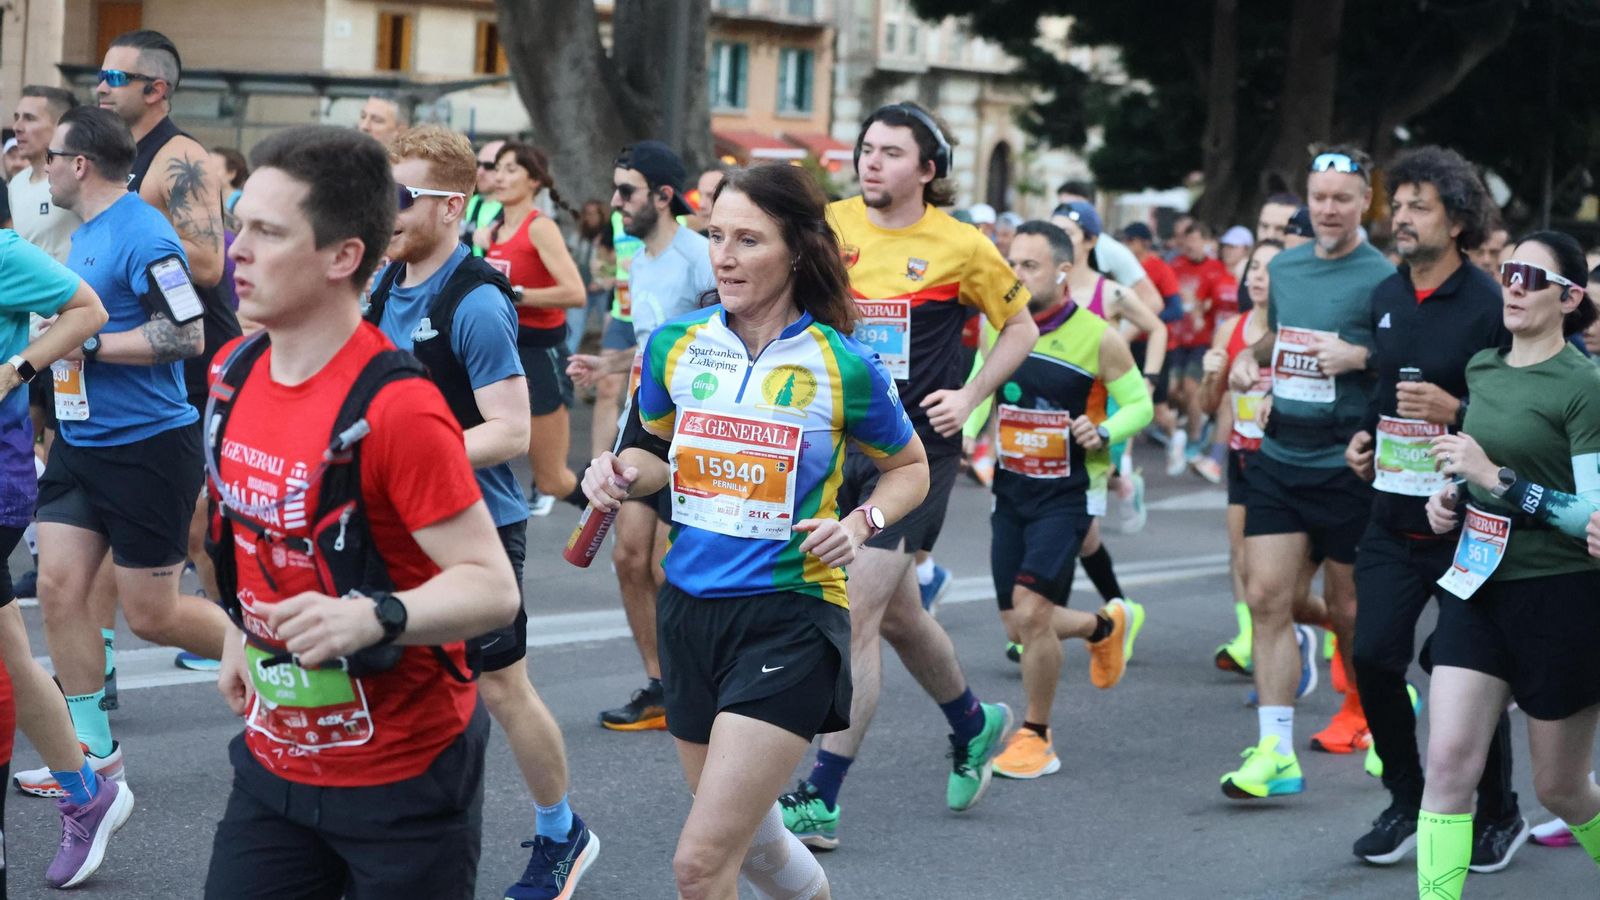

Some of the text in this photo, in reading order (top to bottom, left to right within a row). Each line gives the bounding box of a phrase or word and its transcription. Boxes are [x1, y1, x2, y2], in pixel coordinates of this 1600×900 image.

[858, 305, 902, 317] NERALI
[854, 328, 889, 344] 394
[688, 345, 743, 360] Sparbanken
[689, 357, 738, 372] Lidköping
[1283, 352, 1319, 371] 16172
[693, 382, 715, 392] dina
[704, 418, 790, 446] GENERALI
[1014, 431, 1048, 448] 2853
[222, 439, 285, 476] GENERALI
[694, 454, 765, 485] 15940
[712, 479, 748, 493] PERNILLA
[1522, 483, 1545, 514] OTSO
[748, 510, 770, 519] 21K
[1468, 543, 1489, 564] 561
[255, 656, 310, 688] 6851
